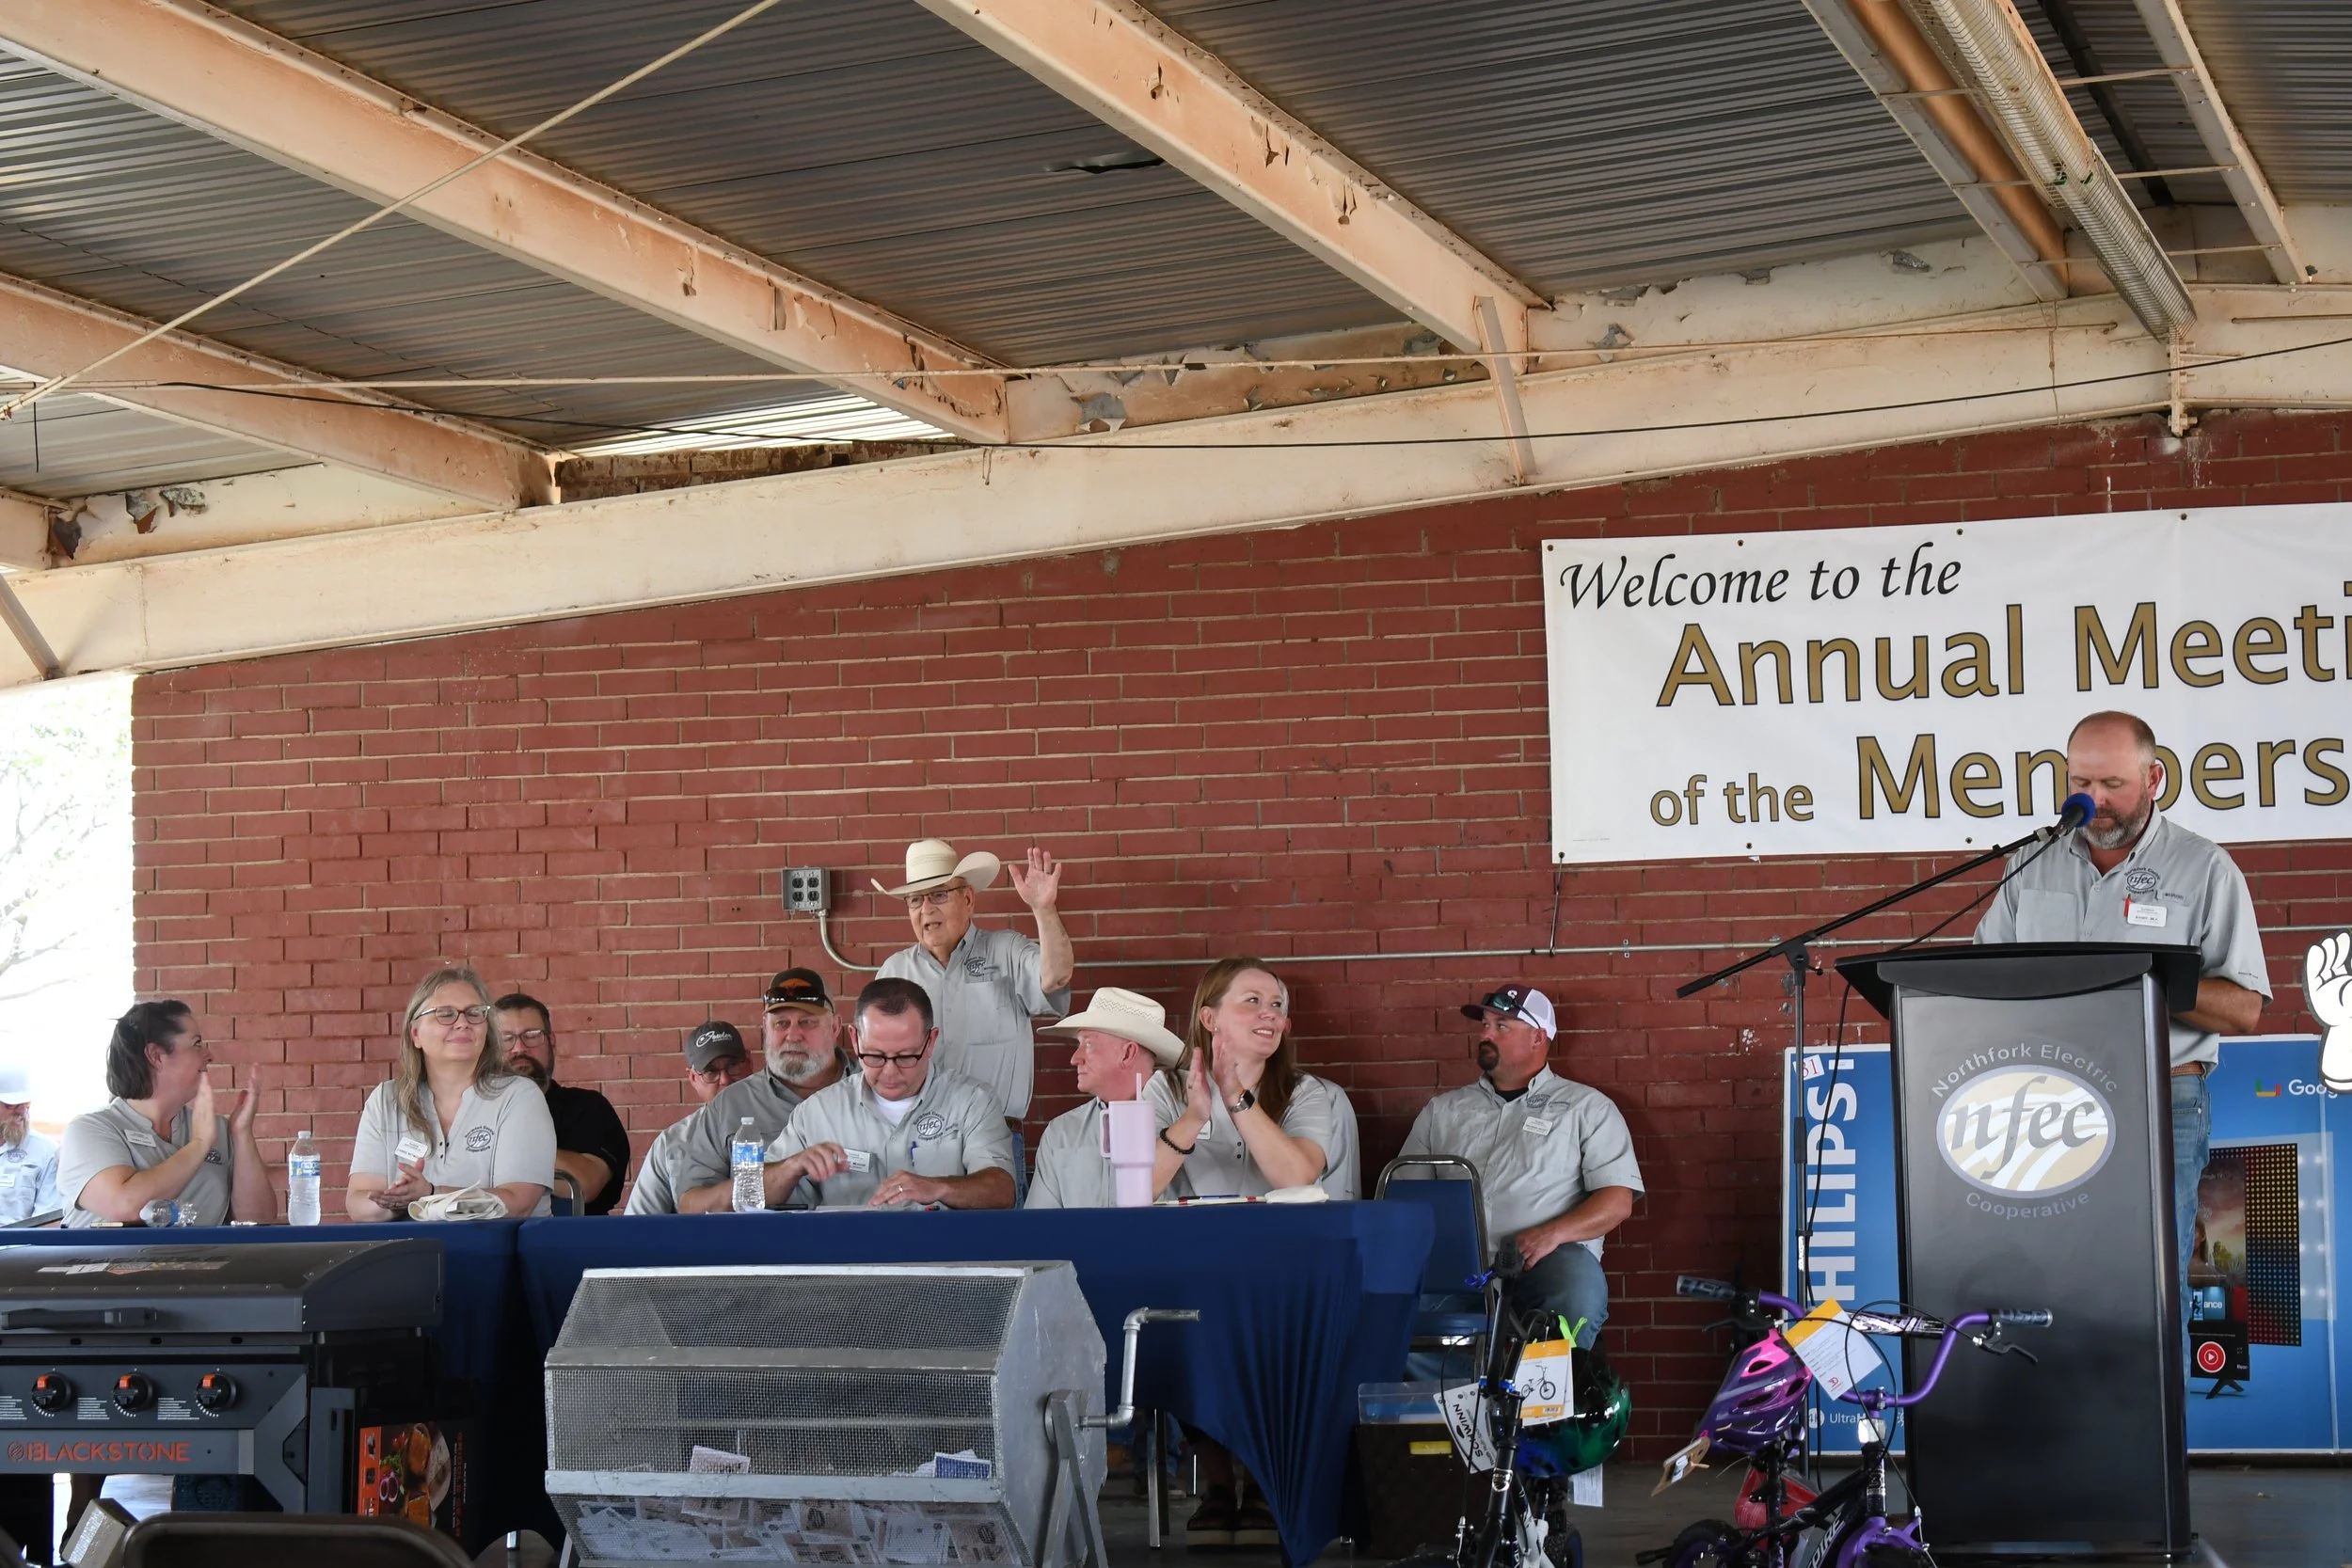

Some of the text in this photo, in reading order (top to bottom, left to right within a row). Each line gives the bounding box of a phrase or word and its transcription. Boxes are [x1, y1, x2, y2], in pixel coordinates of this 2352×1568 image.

[1560, 541, 1962, 610] Welcome to the
[1656, 603, 2025, 707] Annual
[1649, 773, 1708, 827] of
[1723, 772, 1815, 824] the
[1931, 1043, 2118, 1098] Northfork Electric
[1949, 1075, 2097, 1180] nfec
[1807, 1083, 1857, 1301] HILIPS
[1965, 1192, 2090, 1220] Cooperative
[1453, 1403, 1484, 1458] SCHWINN
[1830, 1412, 1867, 1423] UltraH
[26, 1441, 191, 1462] BLACKSTONE
